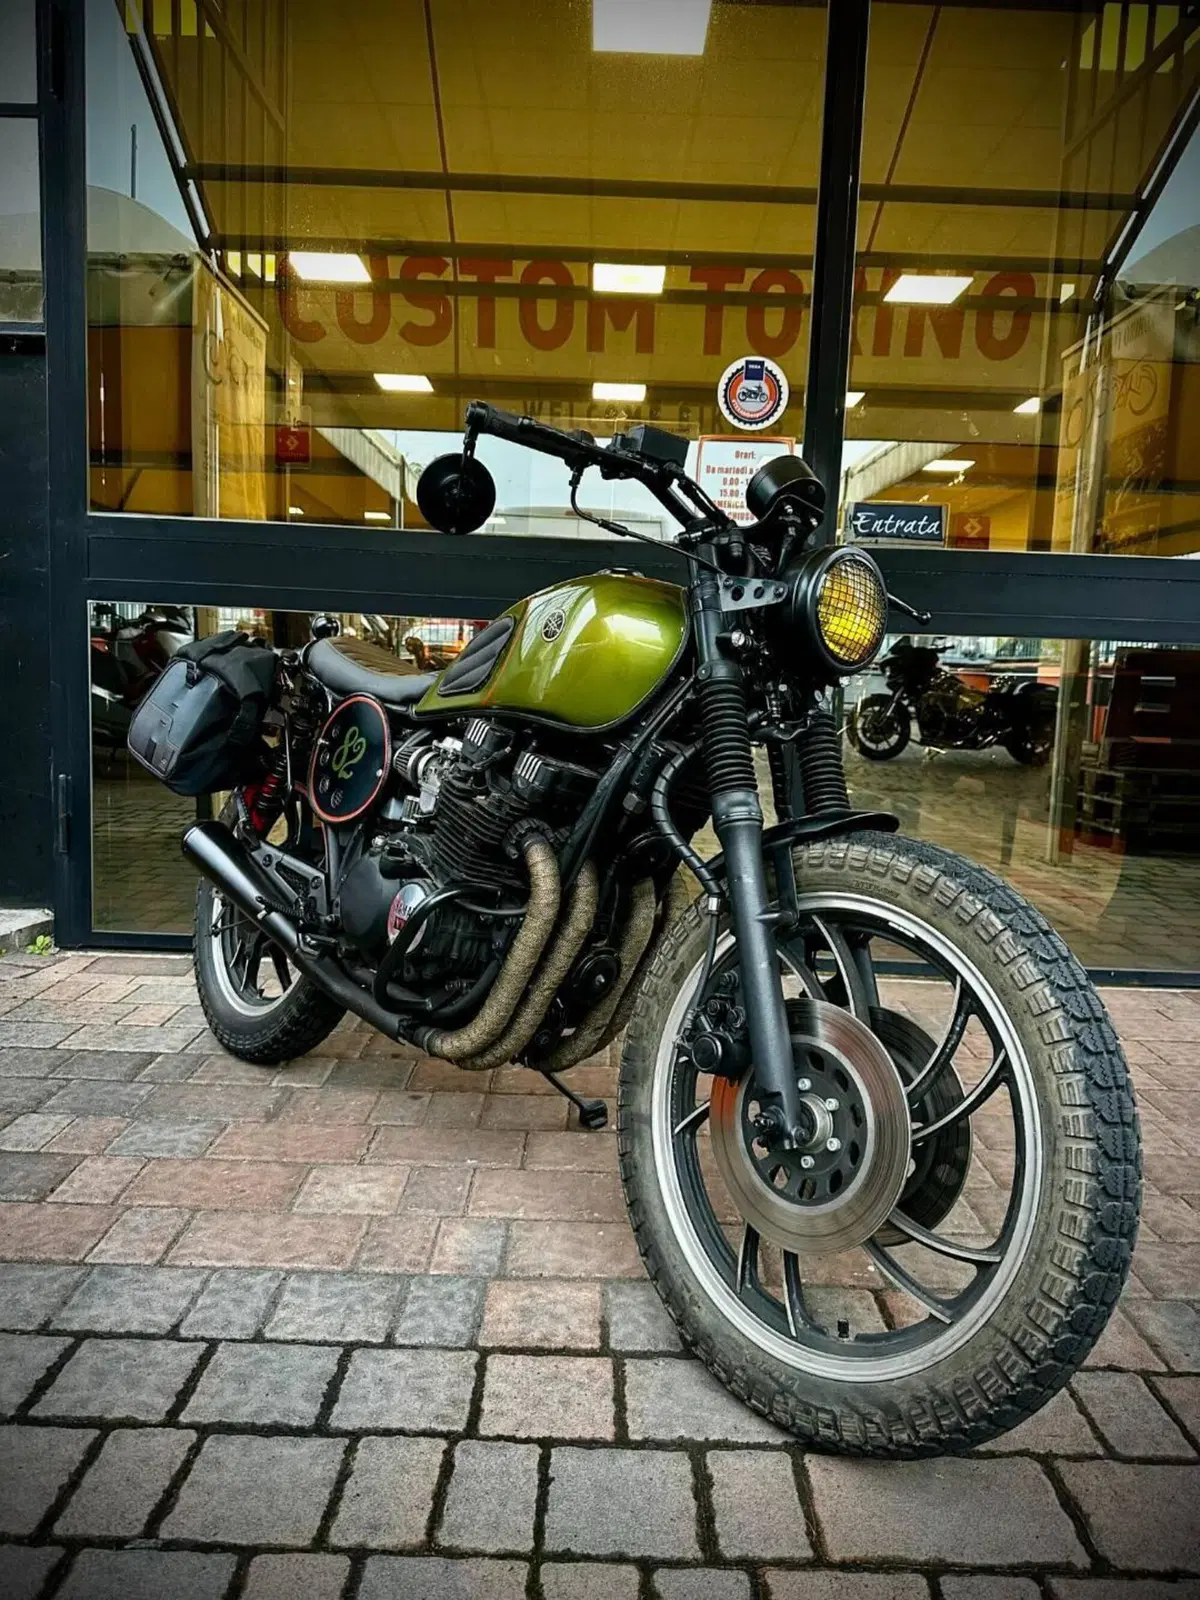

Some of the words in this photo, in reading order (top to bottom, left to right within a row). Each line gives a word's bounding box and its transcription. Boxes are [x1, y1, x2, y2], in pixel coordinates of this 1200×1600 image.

[279, 252, 655, 354] CUSTOM
[690, 264, 1036, 361] TOINO
[712, 500, 745, 509] MENICA
[852, 512, 940, 535] Entrata
[332, 726, 366, 779] 82
